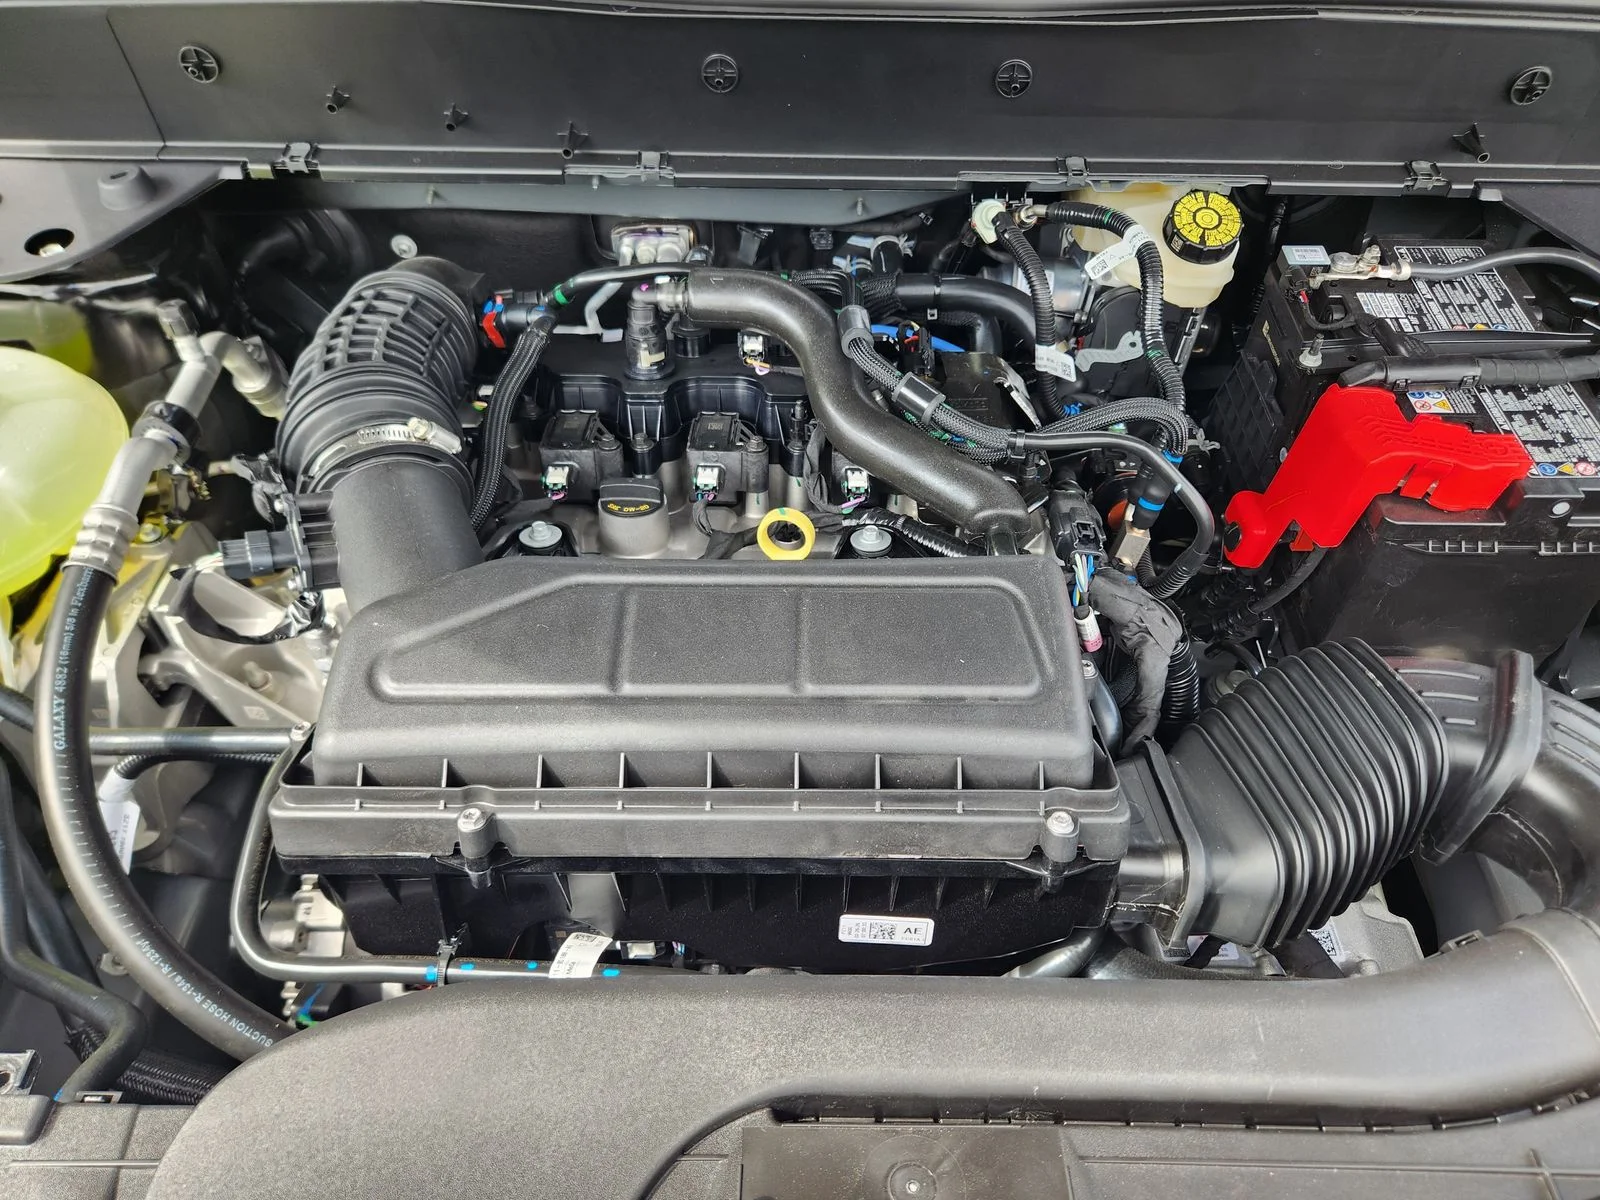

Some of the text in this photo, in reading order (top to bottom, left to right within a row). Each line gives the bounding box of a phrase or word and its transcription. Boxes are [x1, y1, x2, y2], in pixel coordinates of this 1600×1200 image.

[65, 617, 76, 630] 5/8
[58, 632, 74, 664] (16mm)
[54, 666, 68, 692] 4882
[52, 695, 66, 750] GALAXY
[903, 926, 923, 936] AE
[136, 940, 172, 974] R-1234yf
[173, 976, 206, 1004] R-134a
[202, 1000, 232, 1023] HOSE
[228, 1017, 274, 1048] SUCTION
